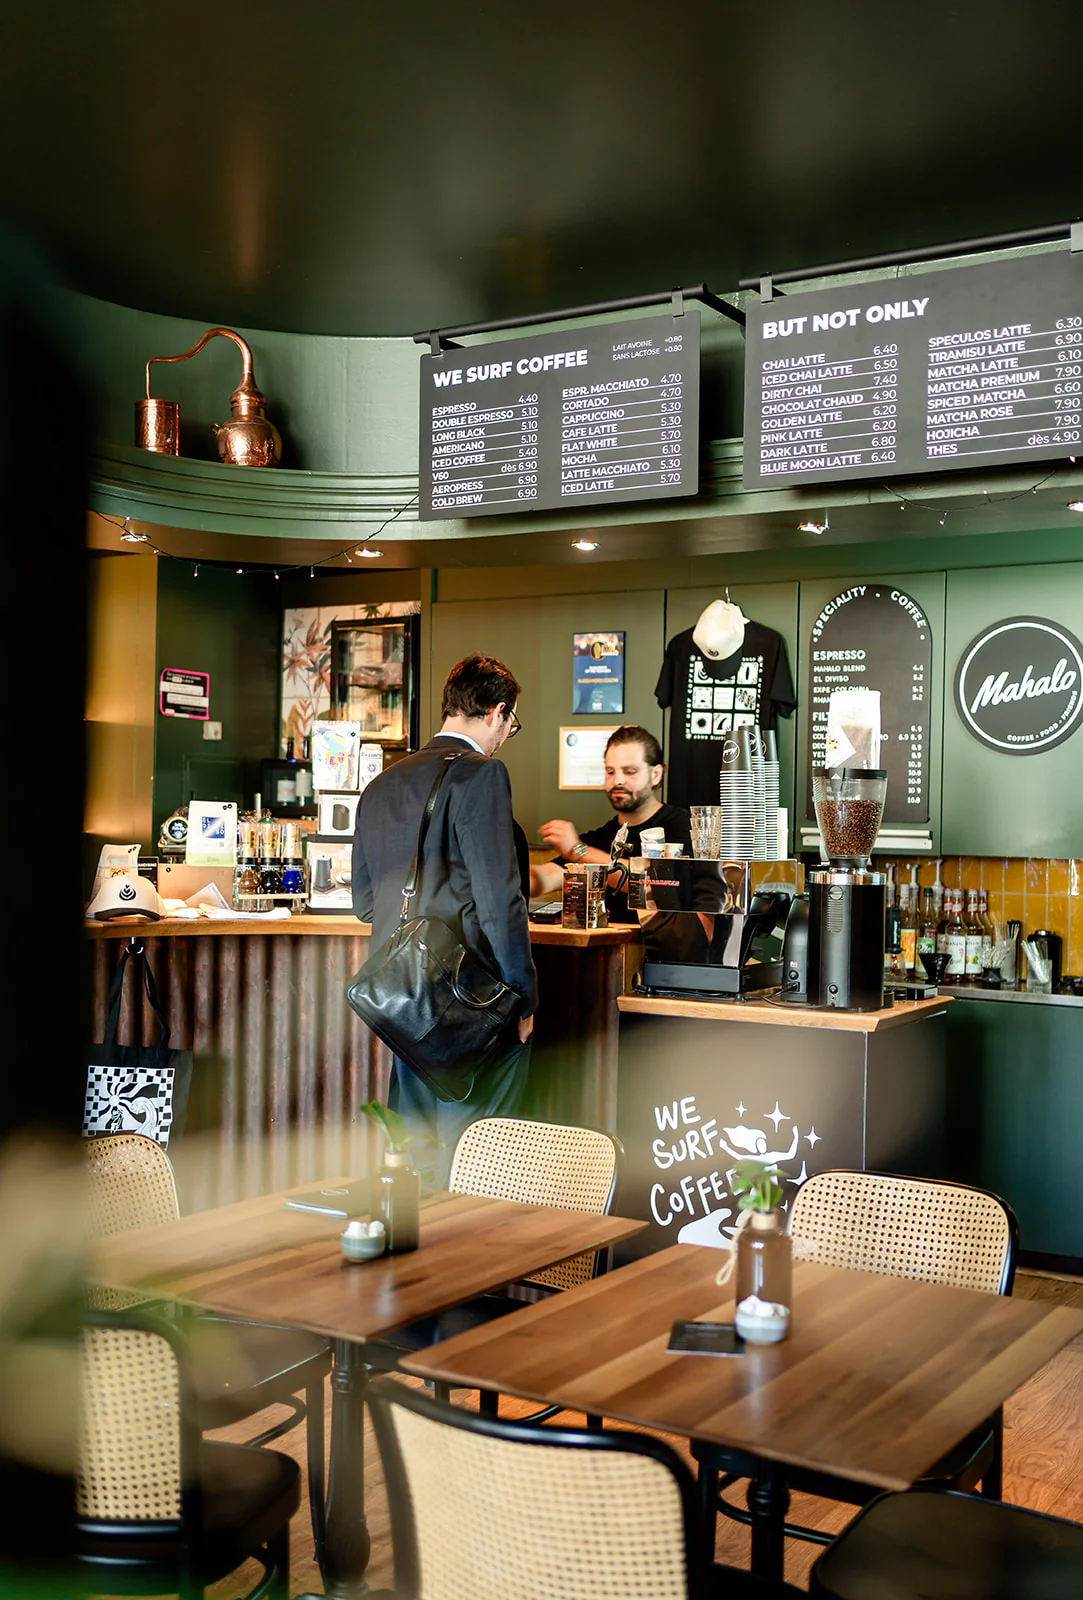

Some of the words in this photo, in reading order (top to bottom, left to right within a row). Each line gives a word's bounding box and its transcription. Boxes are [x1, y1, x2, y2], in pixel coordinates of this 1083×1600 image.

[763, 316, 808, 340] BUT
[813, 308, 861, 332] NOT
[866, 298, 930, 324] ONLY
[612, 343, 627, 352] LAIT
[627, 339, 653, 349] AVOINE
[665, 335, 682, 343] +0.80
[928, 330, 992, 348] SPECULOS
[993, 324, 1031, 338] LATTE
[1055, 317, 1082, 330] 6.30
[612, 352, 630, 361] SANS
[631, 348, 660, 359] LACTOSE
[665, 345, 682, 353] +0.80
[762, 359, 789, 371] CHAI
[791, 353, 826, 366] LATTE
[873, 344, 898, 356] 6.40
[928, 346, 985, 363] TIRAMISU
[988, 340, 1026, 355] LATTE
[1055, 332, 1082, 345] 6.90
[432, 365, 462, 388] WE
[466, 360, 514, 383] SURF
[516, 349, 589, 375] COFFEE
[762, 374, 787, 385] ICED
[789, 369, 816, 382] CHAI
[818, 364, 853, 378] LATTE
[874, 359, 898, 371] 6.50
[927, 363, 979, 379] MATCHA
[981, 357, 1018, 372] LATTE
[1057, 349, 1082, 362] 6.10
[562, 386, 589, 398] ESPR.
[590, 377, 649, 394] MACCHIATO
[660, 373, 682, 383] 4.70
[762, 387, 794, 400] DIRTY
[795, 384, 822, 396] CHAI
[874, 374, 897, 386] 7.40
[927, 379, 979, 394] MATCHA
[981, 370, 1040, 387] PREMIUM
[1055, 365, 1081, 378] 7.90
[432, 402, 477, 416] ESPRESSO
[518, 393, 538, 404] 4.40
[562, 397, 609, 411] CORTADO
[660, 387, 681, 397] 4.70
[761, 399, 821, 415] CHOCOLAT
[823, 394, 864, 407] CHAUD
[872, 389, 897, 401] 4.90
[927, 395, 971, 410] SPICED
[973, 389, 1026, 404] MATCHA
[1054, 381, 1081, 394] 6.60
[432, 416, 467, 429] DOUBLE
[468, 410, 514, 424] ESPRESSO
[521, 407, 538, 417] 5.10
[562, 409, 625, 425] CAPPUCCINO
[661, 401, 681, 412] 5.30
[761, 415, 806, 430] GOLDEN
[808, 411, 842, 424] LATTE
[873, 405, 897, 416] 6.20
[927, 410, 978, 425] MATCHA
[980, 406, 1013, 419] ROSE
[1055, 398, 1080, 410] 7.90
[432, 432, 456, 442] LONG
[457, 427, 486, 439] BLACK
[521, 420, 538, 431] 5.10
[562, 427, 587, 438] CAFE
[588, 423, 618, 436] LATTE
[660, 416, 681, 426] 5.30
[761, 432, 787, 444] PINK
[789, 428, 823, 441] LATTE
[872, 420, 896, 432] 6.20
[926, 425, 980, 441] HOJICHA
[1054, 414, 1080, 427] 7.90
[432, 440, 485, 456] AMERICANO
[521, 434, 538, 444] 5.10
[561, 441, 585, 453] FLAT
[586, 437, 618, 449] WHITE
[660, 430, 681, 441] 5.70
[760, 447, 791, 459] DARK
[793, 443, 828, 456] LATTE
[871, 435, 896, 447] 6.80
[926, 443, 958, 456] THES
[1027, 433, 1050, 446] dès
[1052, 431, 1080, 443] 4.90
[432, 458, 452, 469] ICED
[453, 453, 486, 465] COFFEE
[518, 447, 538, 458] 5.40
[561, 454, 597, 466] MOCHA
[662, 444, 681, 455] 6.10
[760, 462, 788, 474] BLUE
[790, 458, 825, 470] MOON
[827, 454, 862, 466] LATTE
[871, 451, 896, 462] 6.40
[432, 471, 449, 481] V60
[501, 463, 517, 473] dès
[518, 461, 537, 471] 6.90
[561, 468, 590, 480] LATTE
[592, 462, 650, 477] MACCHIATO
[660, 459, 681, 469] 5.30
[432, 481, 484, 495] AEROPRESS
[518, 474, 537, 485] 6.90
[561, 483, 583, 494] ICED
[585, 480, 614, 491] LATTE
[660, 473, 680, 483] 5.70
[431, 497, 455, 508] COLD
[456, 493, 483, 505] BREW
[517, 488, 537, 498] 6.90
[812, 585, 867, 637] SPECIALITY
[890, 590, 927, 628] COFFEE
[813, 650, 866, 661] ESPRESSO
[843, 664, 866, 672] BLEND
[970, 658, 1077, 714] Mahalo
[1007, 734, 1035, 742] COFFEE
[1040, 722, 1059, 738] FOOD
[1061, 690, 1078, 720] FRIENDS
[654, 1096, 701, 1131] WE
[652, 1119, 718, 1169] SURF
